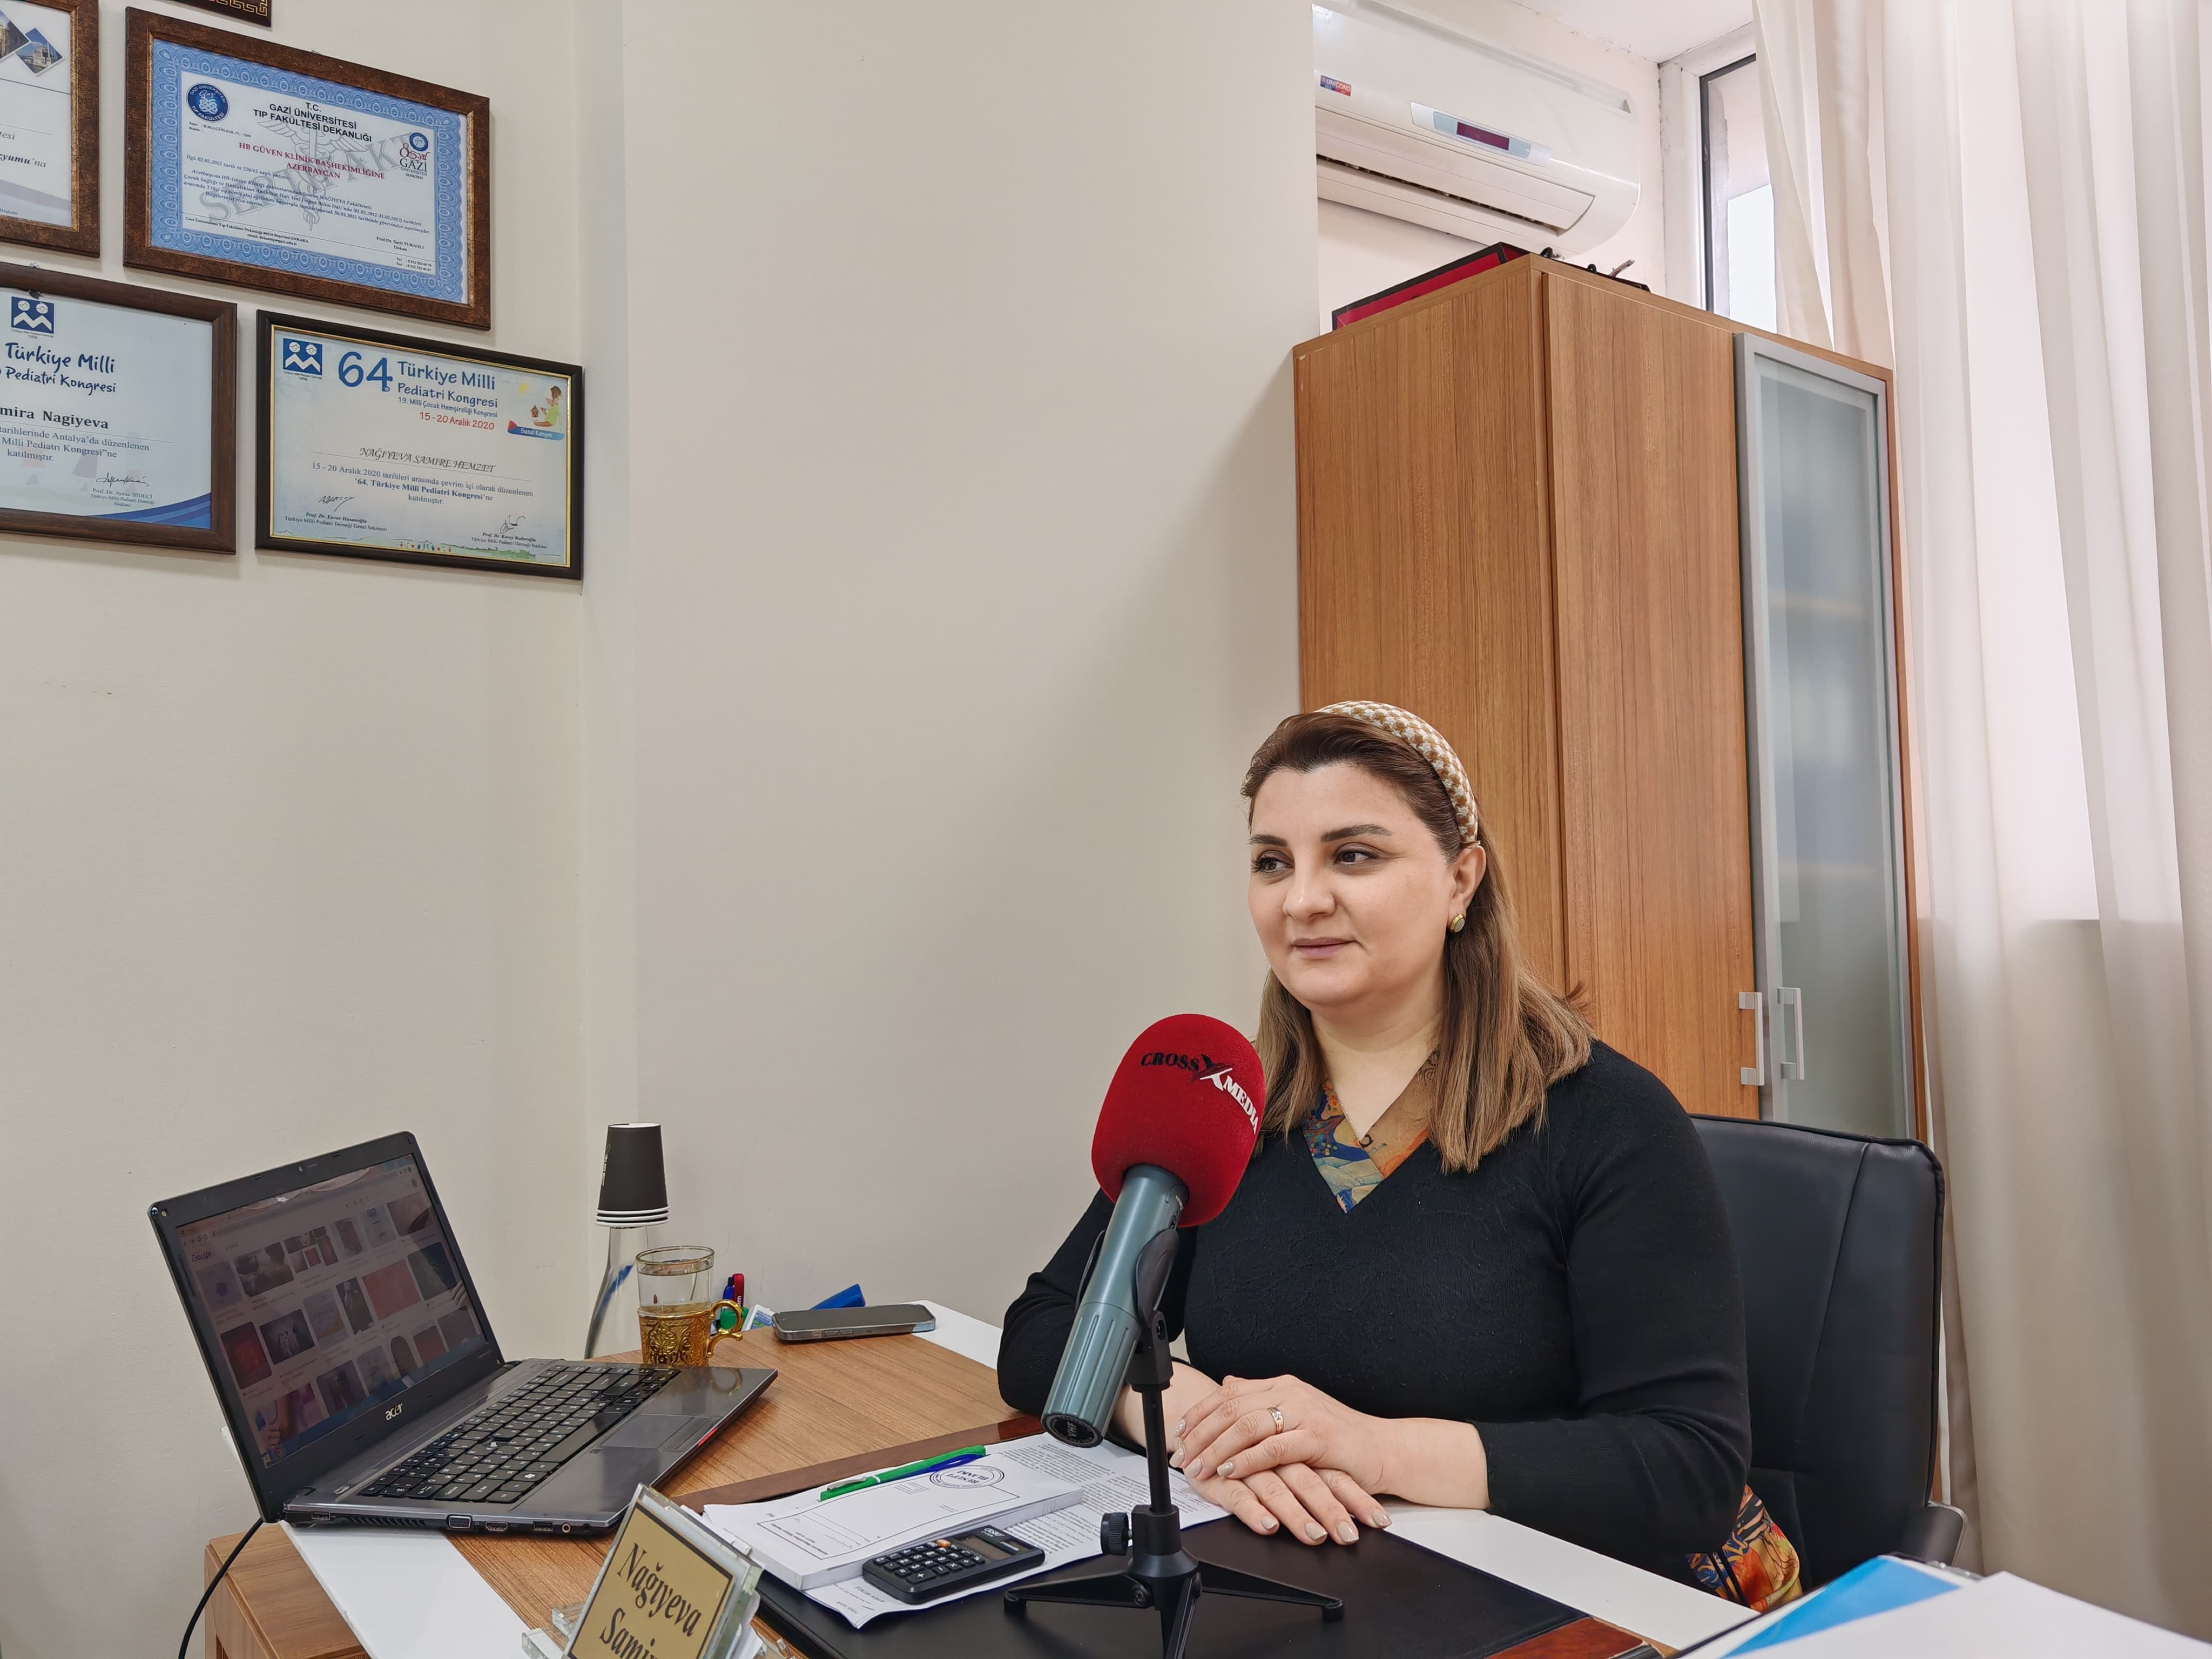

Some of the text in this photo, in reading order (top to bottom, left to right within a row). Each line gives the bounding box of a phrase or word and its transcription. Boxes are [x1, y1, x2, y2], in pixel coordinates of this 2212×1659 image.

[1326, 78, 1351, 92] UNICOND
[269, 103, 356, 130] GAZİ ÜNİVERSİTESİ
[305, 102, 321, 112] T.C.
[253, 109, 372, 143] TIP FAKÜLTESİ DEKANLIĞI
[198, 157, 222, 166] 02.02.2012
[253, 145, 282, 157] GÜVEN
[285, 151, 313, 163] KLİNİK
[315, 159, 385, 179] BAŞHEKİMLİĞİNE
[286, 163, 340, 179] AZERBAYCAN
[400, 158, 428, 172] GAZİ
[192, 169, 220, 179] Azerbaycan
[5, 342, 115, 374] Türkiye Milli
[5, 366, 116, 396] Pediatri Kongresi
[338, 351, 495, 392] 64 Türkiye Milli
[397, 382, 498, 408] Pediatri Kongresi
[397, 396, 408, 404] 19.
[422, 400, 440, 409] Çocuk
[441, 403, 473, 415] Hemşireliği
[474, 408, 497, 417] Kongresi
[43, 410, 109, 429] Nagiyeva
[419, 412, 495, 430] 15 20 Aralık 2020
[2, 437, 24, 447] Milli
[27, 440, 60, 451] Pediatri
[102, 439, 150, 451] düzenlenen
[328, 464, 337, 472] 20
[339, 466, 361, 475] Aralık
[363, 469, 381, 477] 2020
[383, 471, 409, 481] tarihleri
[412, 476, 439, 485] arasında
[441, 480, 464, 489] çevrim
[476, 484, 496, 493] olarak
[497, 487, 533, 497] düzenlenen
[371, 479, 400, 490] Türkiye
[402, 484, 419, 493] Milli
[421, 487, 449, 496] Pediatri
[1141, 1052, 1200, 1071] CROSS
[385, 1402, 403, 1421] acer
